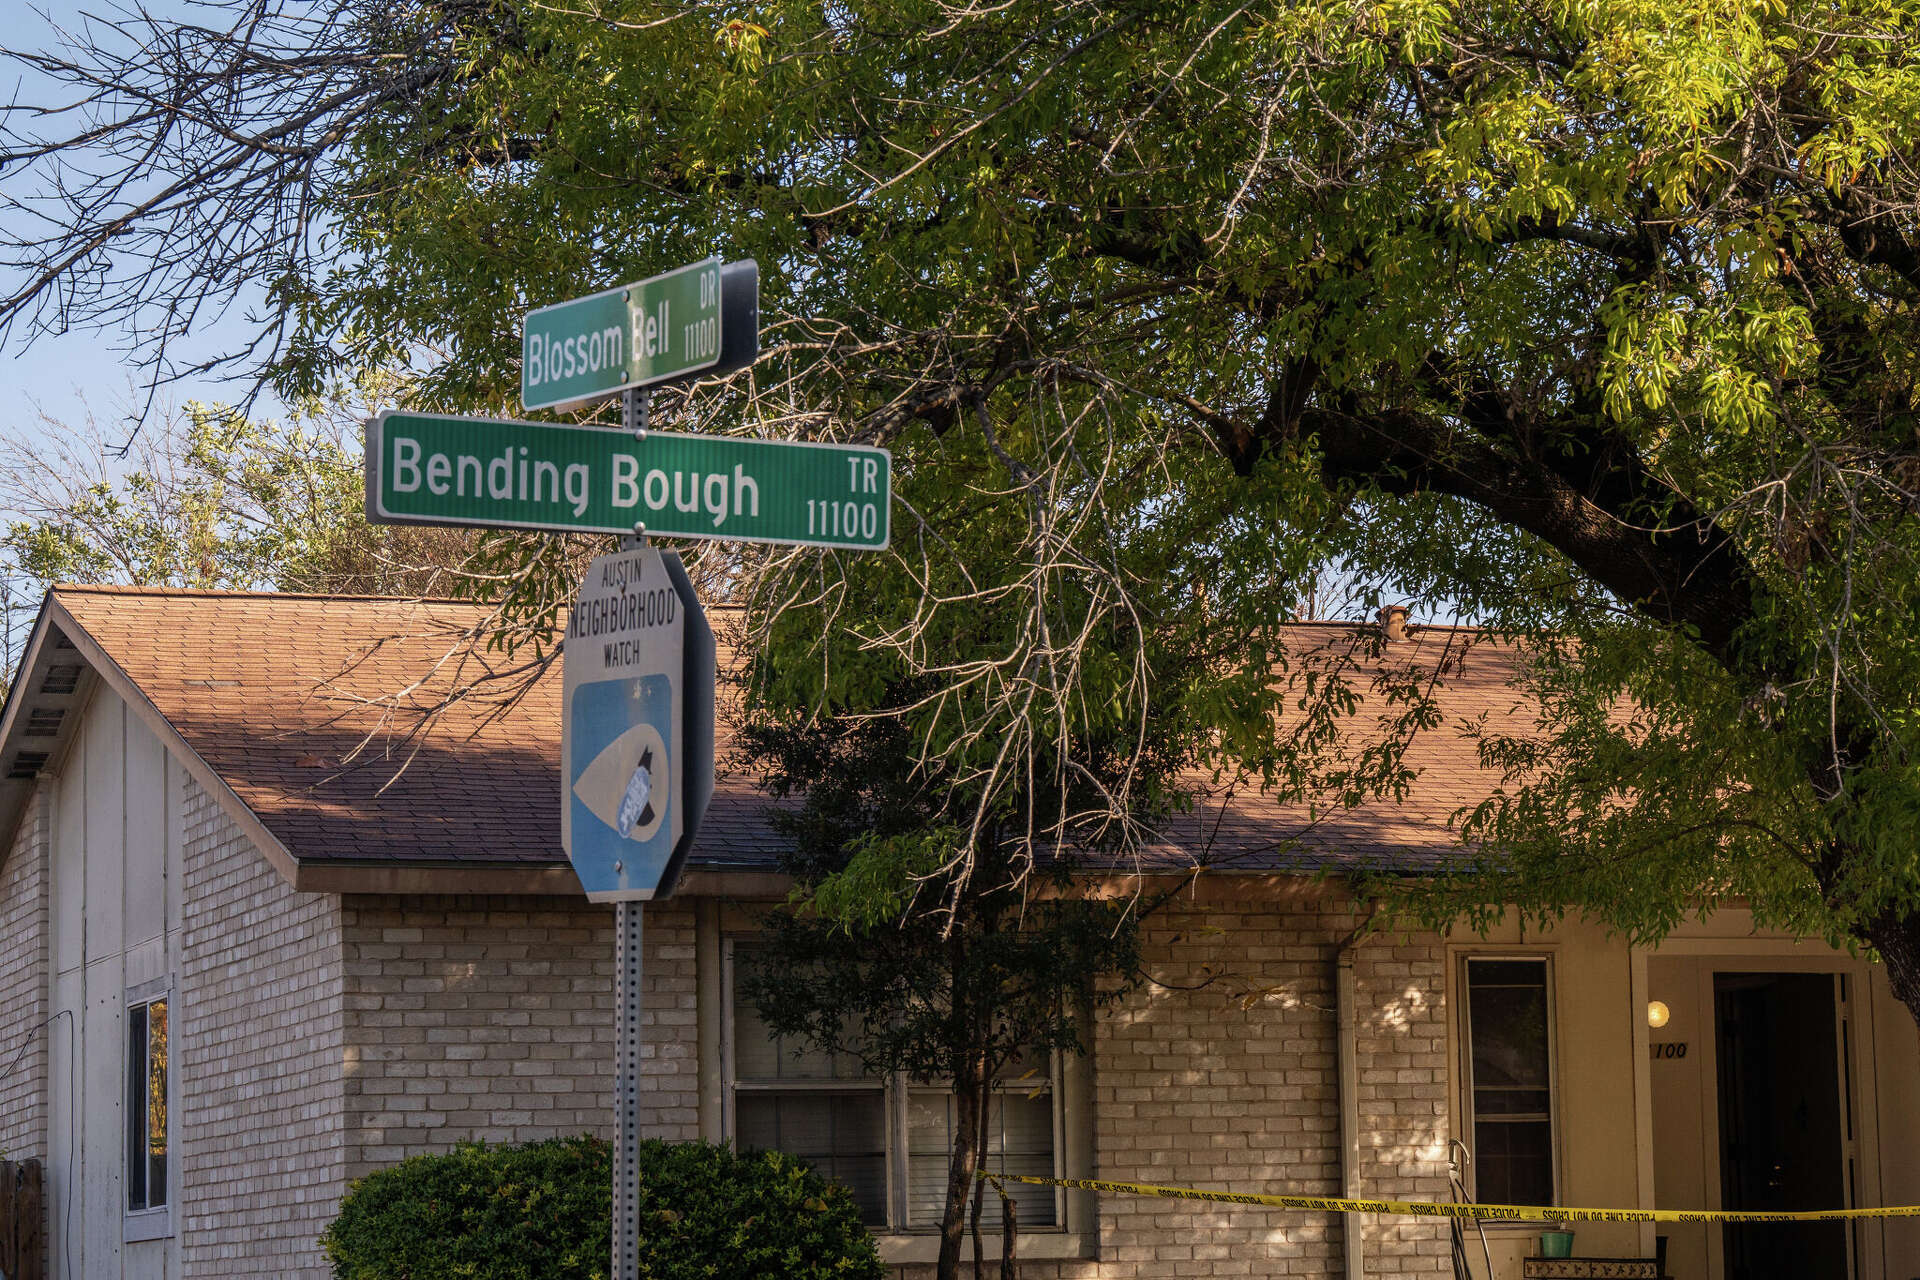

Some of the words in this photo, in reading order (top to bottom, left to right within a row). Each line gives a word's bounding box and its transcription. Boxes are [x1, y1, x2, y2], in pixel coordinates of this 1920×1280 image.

[701, 271, 715, 309] DR
[529, 326, 622, 386] Blossom
[632, 300, 669, 362] Bell
[684, 317, 716, 362] 11100
[847, 456, 878, 494] TR
[392, 437, 590, 518] Bending
[611, 454, 759, 528] Bough
[806, 498, 877, 539] 11100
[602, 558, 641, 587] AUSTIN
[570, 589, 675, 638] NEIGHBORHOOD
[603, 640, 640, 668] WATCH
[1649, 1043, 1686, 1058] 100
[1281, 1199, 1309, 1208] CROSS
[1309, 1200, 1326, 1209] NOT
[1327, 1201, 1339, 1210] DO
[1340, 1202, 1359, 1212] LINE
[1360, 1203, 1390, 1213] POLICE
[1410, 1205, 1438, 1215] CROSS
[1439, 1206, 1456, 1216] NOT
[1458, 1207, 1469, 1217] DO
[1471, 1208, 1490, 1218] LINE
[1492, 1208, 1520, 1218] POLICE
[1543, 1210, 1569, 1222] CROSS
[1572, 1212, 1588, 1221] NOT
[1591, 1212, 1602, 1222] DO
[1605, 1213, 1623, 1222] LINE
[1626, 1213, 1655, 1222] POLICE
